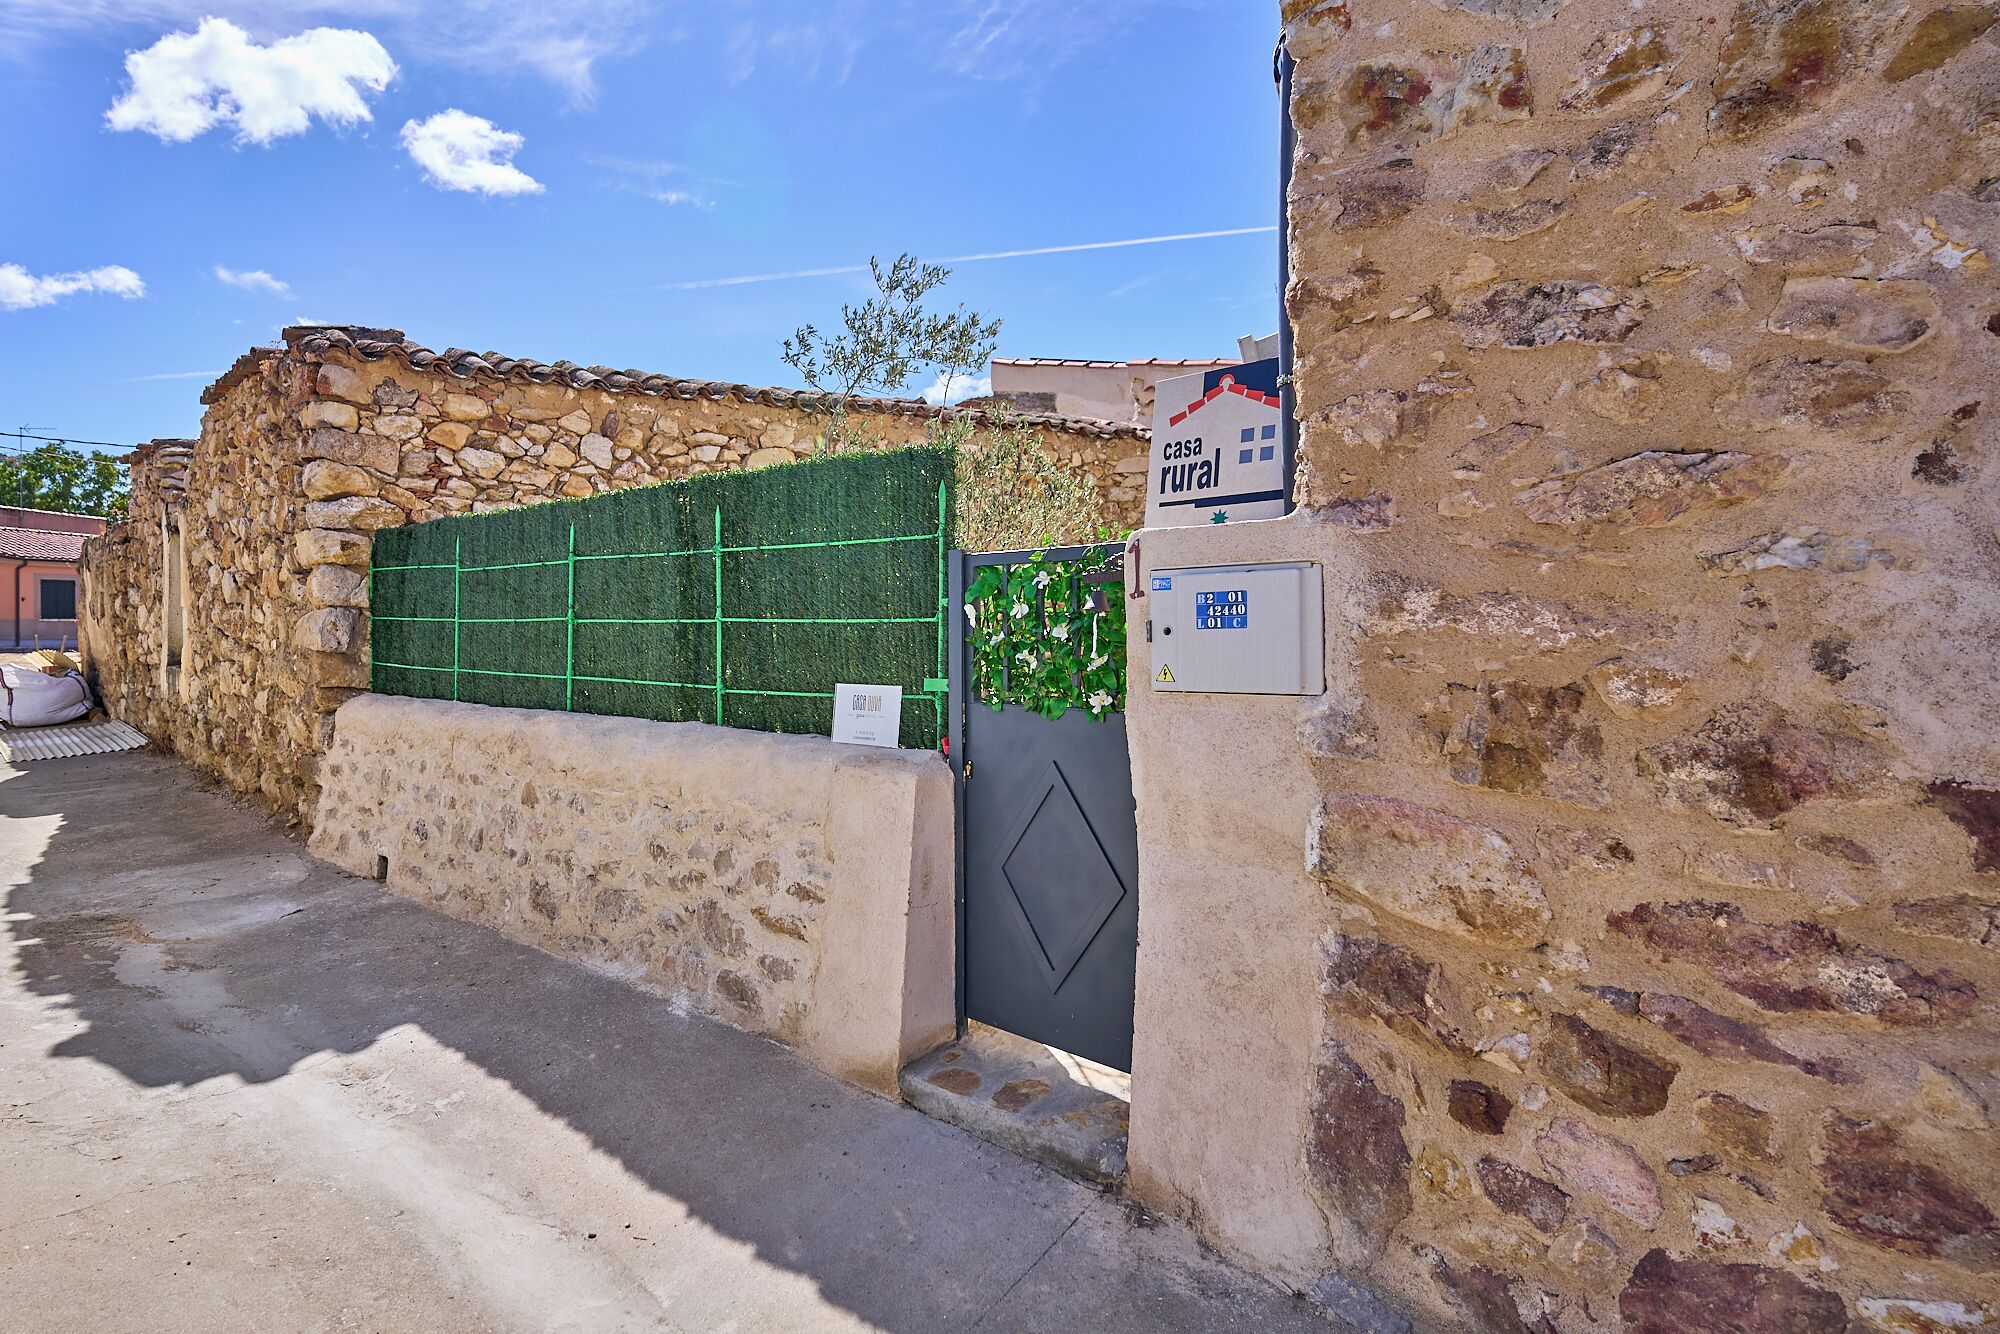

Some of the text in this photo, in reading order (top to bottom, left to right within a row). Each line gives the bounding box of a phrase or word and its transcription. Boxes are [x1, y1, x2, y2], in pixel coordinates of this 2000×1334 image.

[1163, 437, 1203, 461] casa
[1160, 447, 1221, 495] rural
[1127, 538, 1145, 600] 1
[1228, 591, 1243, 602] 01
[1207, 604, 1246, 616] 42440
[1232, 617, 1241, 628] C
